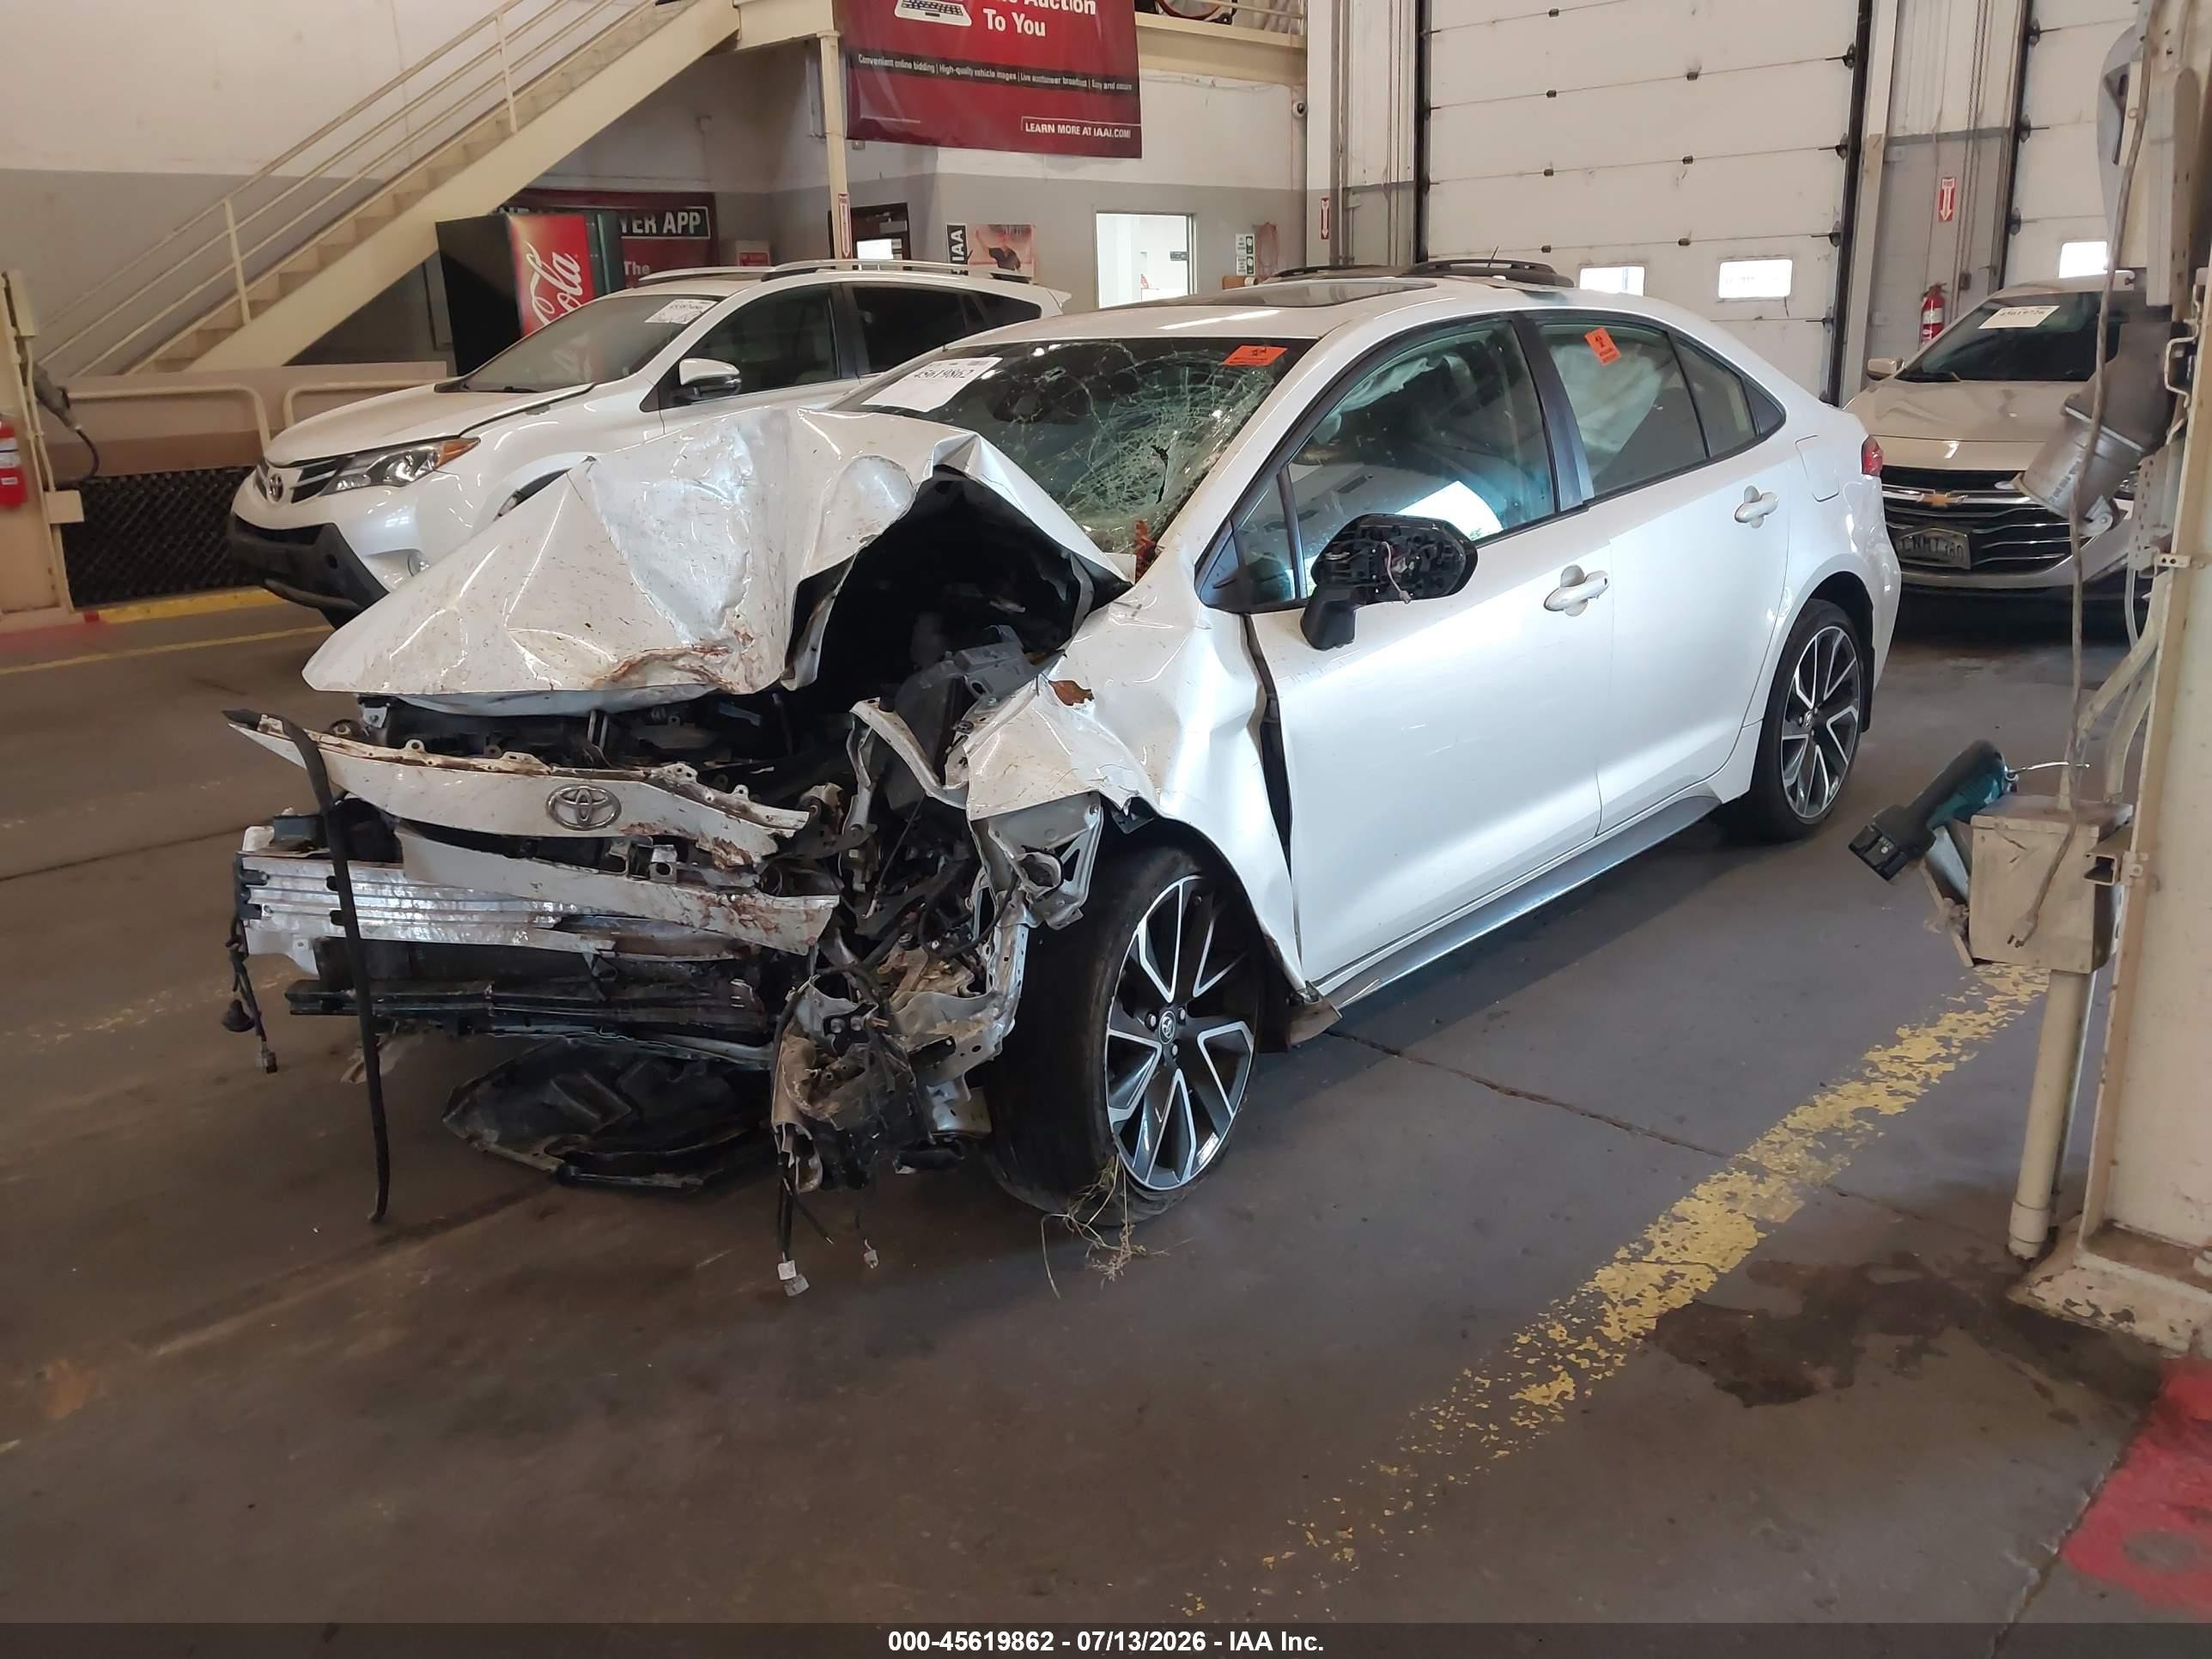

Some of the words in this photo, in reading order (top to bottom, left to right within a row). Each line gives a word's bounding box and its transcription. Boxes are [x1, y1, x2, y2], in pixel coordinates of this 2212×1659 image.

[1024, 0, 1097, 15] uction
[982, 8, 1005, 32] To
[1011, 12, 1046, 37] You
[913, 61, 934, 74] bidding
[1103, 82, 1115, 90] and
[1025, 122, 1055, 134] LEARN
[1057, 125, 1080, 135] MORE
[1082, 126, 1091, 136] AT
[663, 211, 701, 234] APP
[951, 229, 964, 261] IAA
